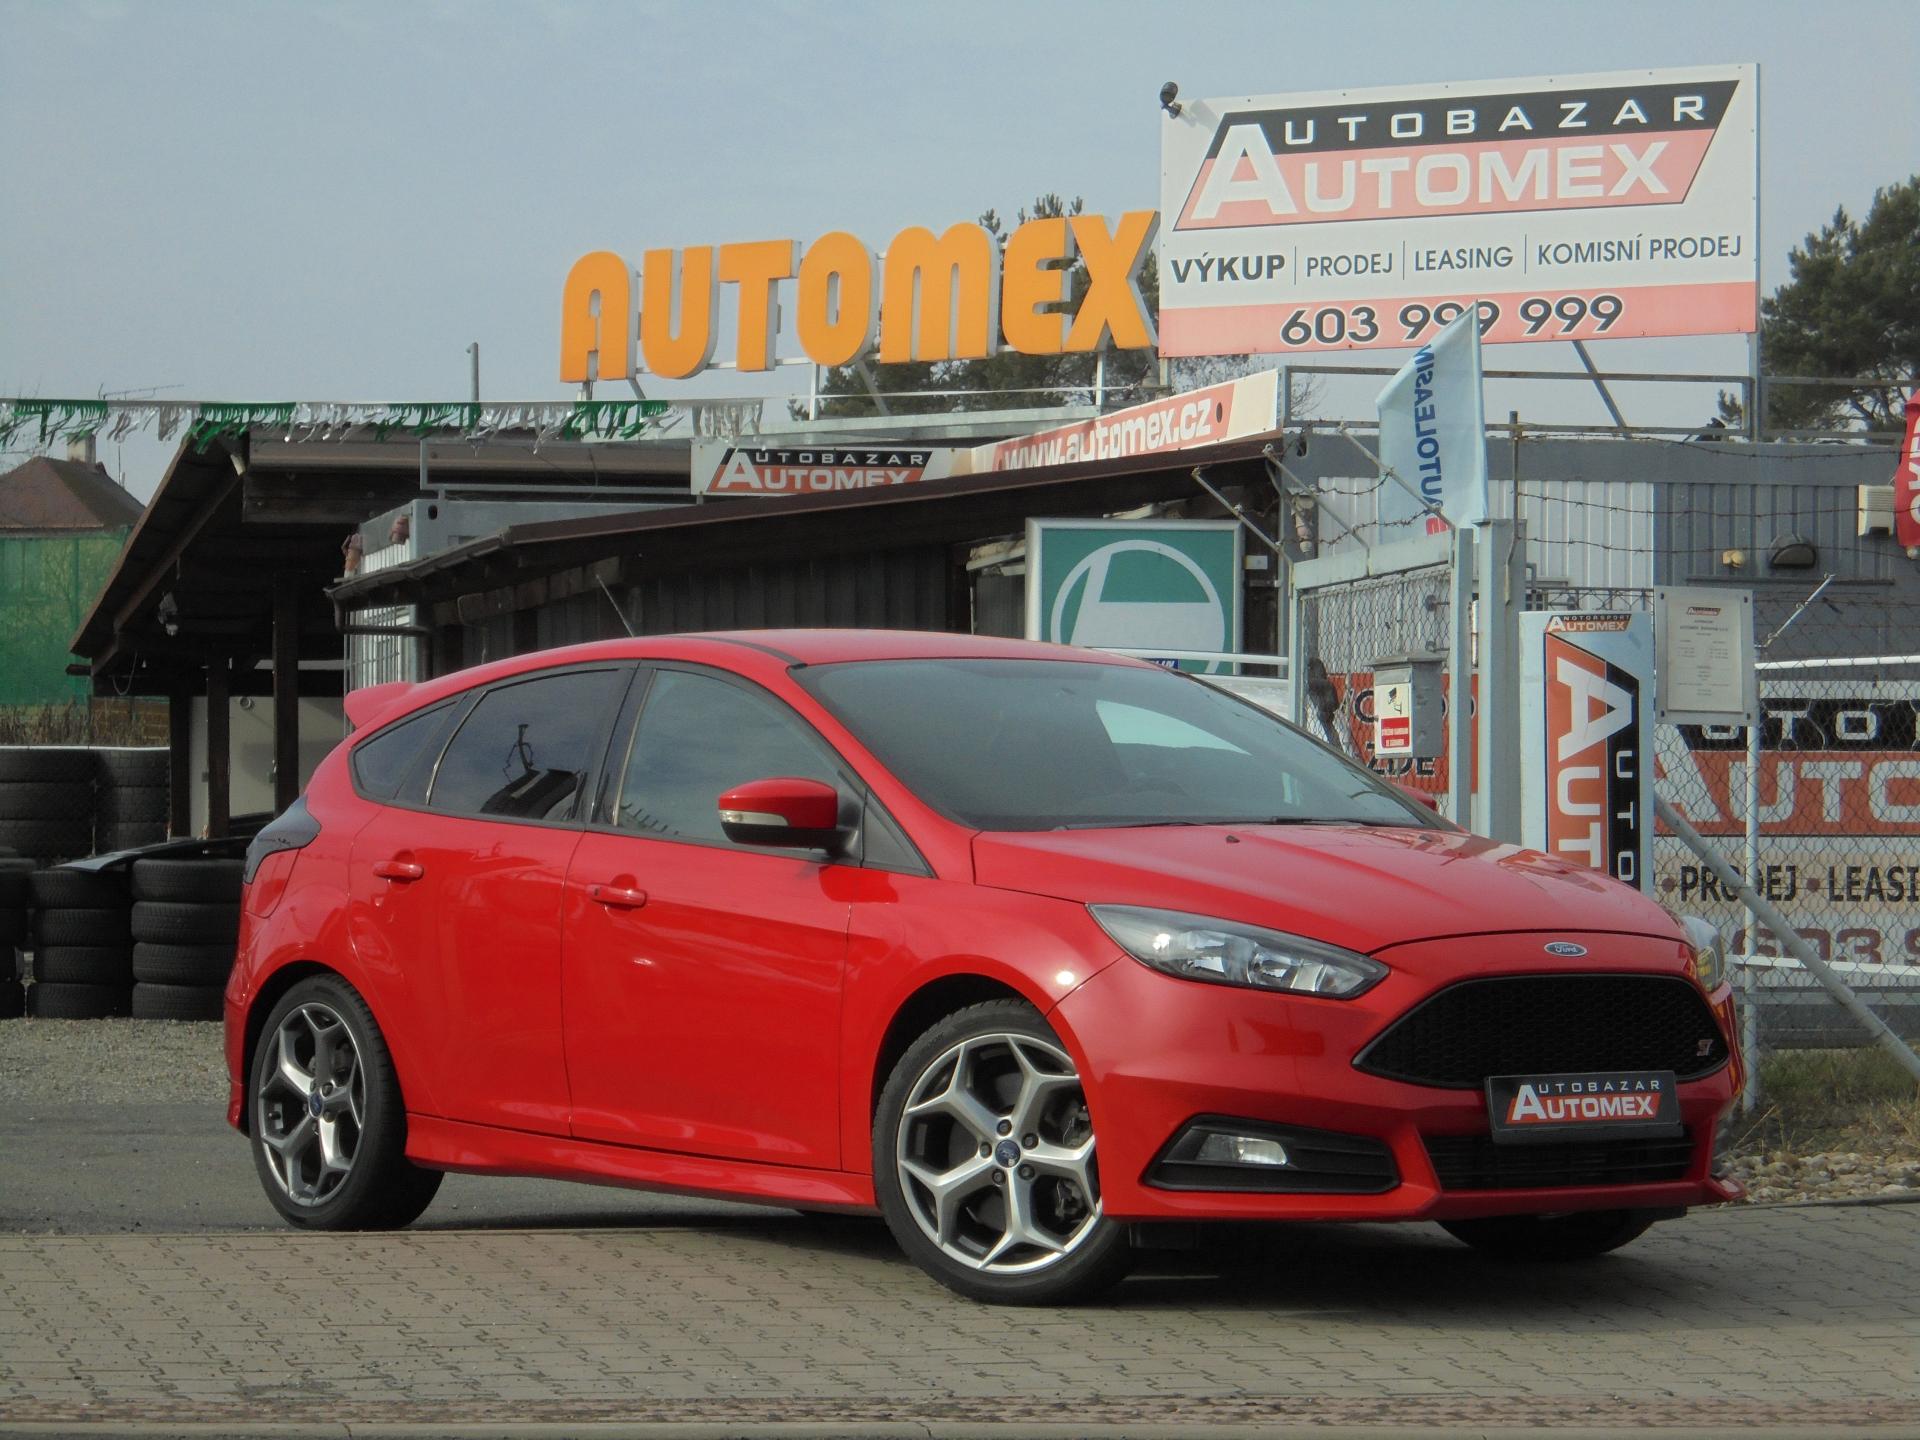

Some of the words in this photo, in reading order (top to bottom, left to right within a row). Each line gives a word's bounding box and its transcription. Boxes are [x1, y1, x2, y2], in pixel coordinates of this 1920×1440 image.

[1190, 123, 1670, 221] AUTOMEX
[1171, 252, 1286, 284] VÝKUP
[1306, 252, 1394, 278] PRODEJ
[1414, 246, 1514, 272] LEASING
[1537, 234, 1643, 266] KOMISNÍ
[1649, 235, 1742, 260] PRODEJ
[559, 209, 1161, 383] AUTOMEX
[1281, 306, 1379, 347] 603
[1398, 300, 1501, 341] 999
[1518, 293, 1624, 336] 999
[1004, 398, 1212, 471] www.automex.cz
[716, 451, 911, 490] AUTOMEX
[1547, 616, 1625, 632] AUTOMEX
[1511, 1084, 1655, 1121] AUTOMEX
